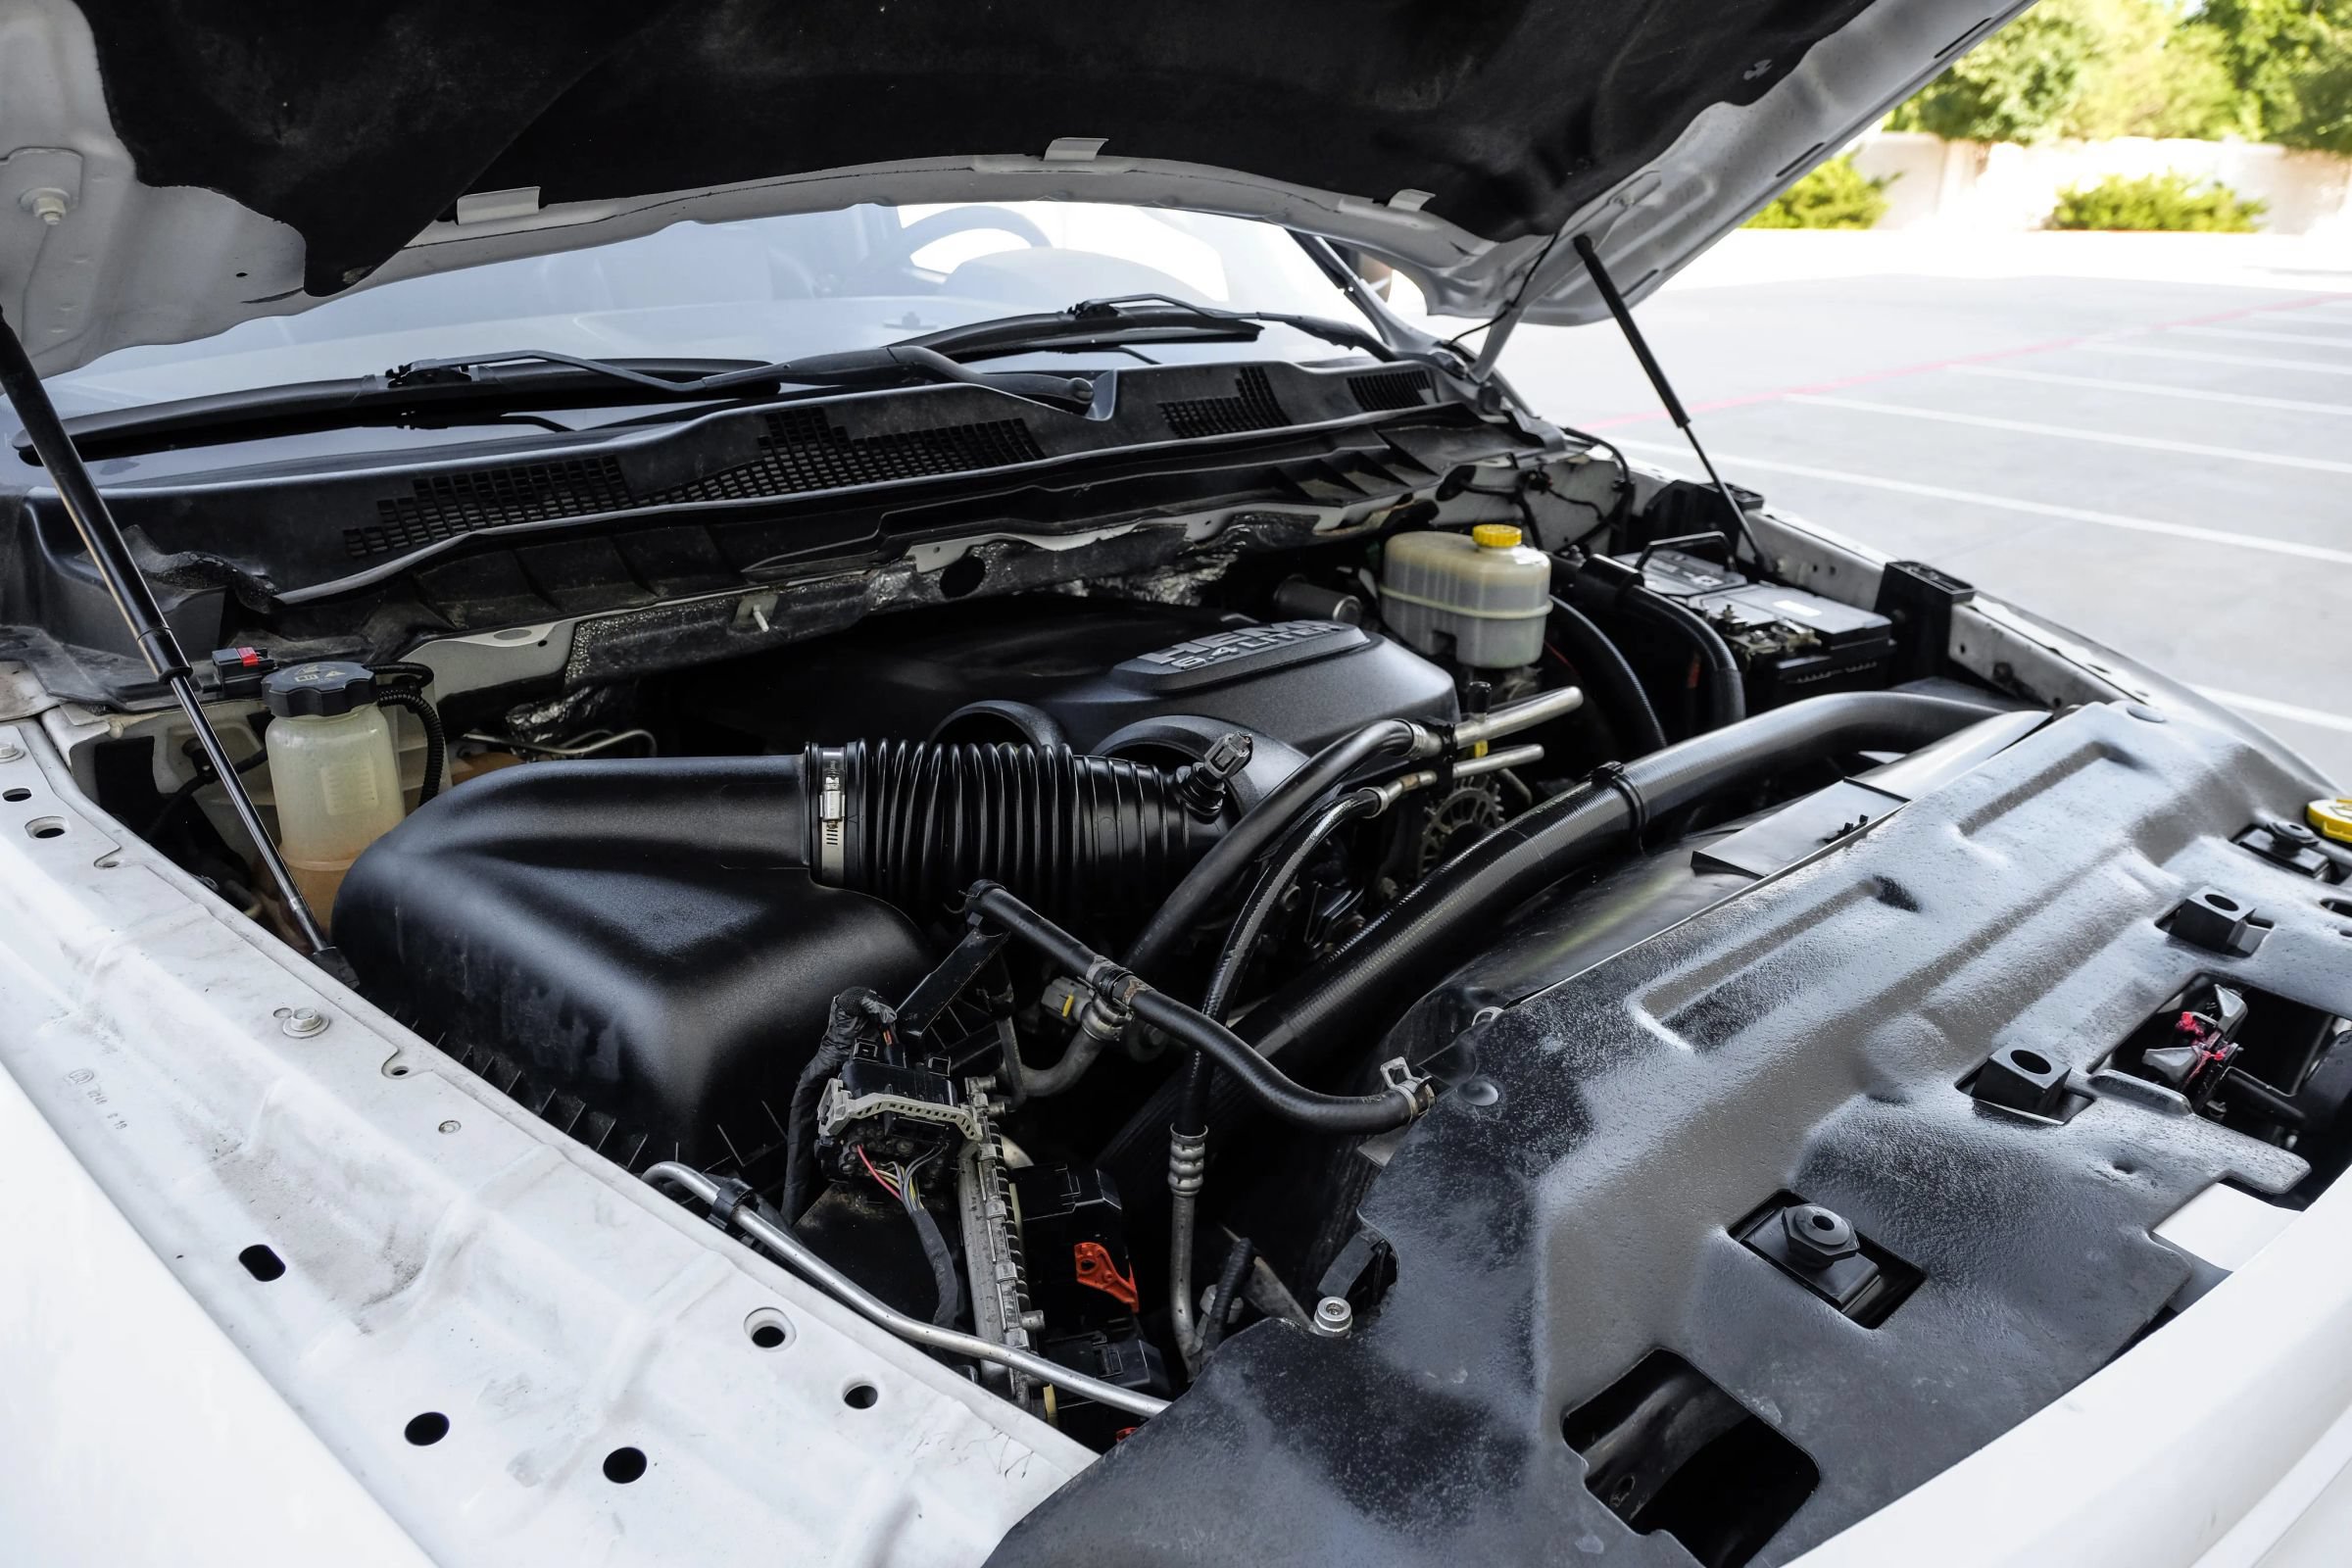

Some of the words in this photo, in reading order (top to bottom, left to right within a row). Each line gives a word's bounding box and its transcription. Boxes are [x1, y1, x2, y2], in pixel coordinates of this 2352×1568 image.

[1137, 619, 1331, 665] HEMI
[1171, 646, 1239, 670] 6.4
[1238, 623, 1346, 650] LITER
